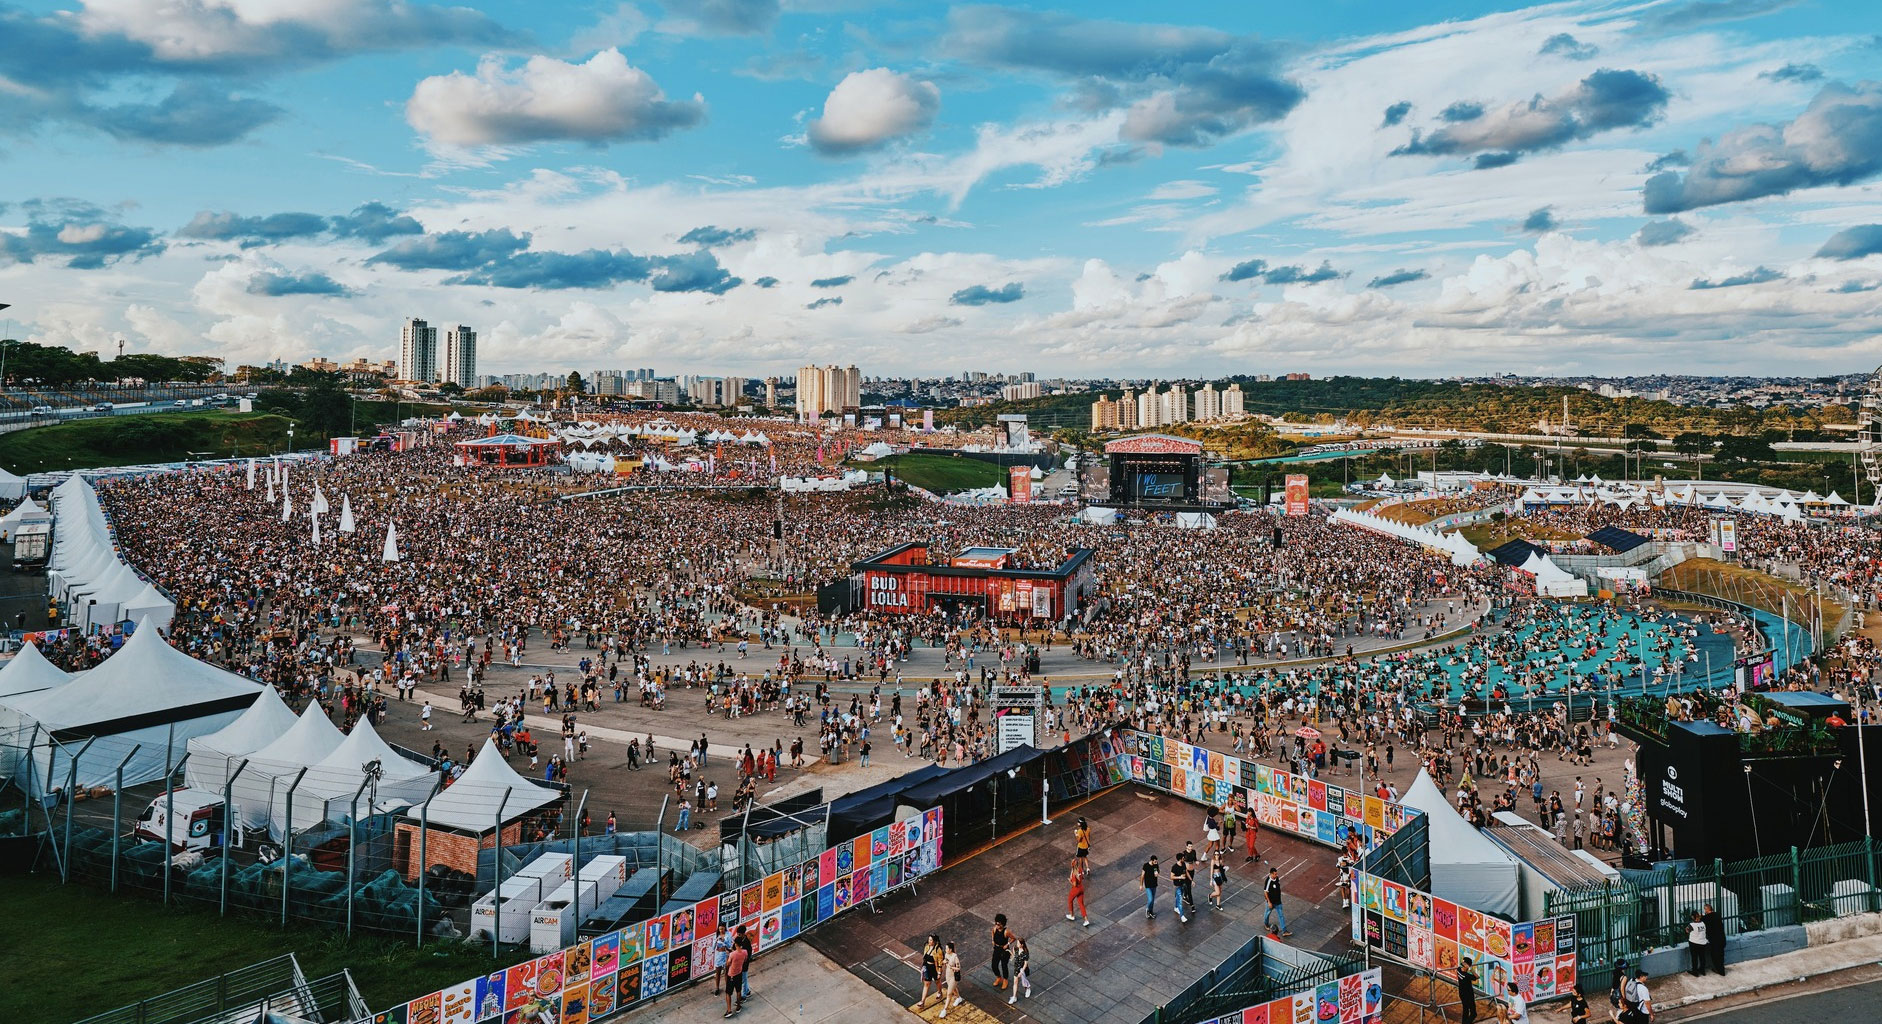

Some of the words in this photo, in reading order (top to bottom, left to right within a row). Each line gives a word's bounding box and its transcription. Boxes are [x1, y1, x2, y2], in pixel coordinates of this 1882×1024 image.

[1144, 482, 1182, 496] FEET
[1662, 779, 1683, 796] MULTI
[1662, 786, 1684, 804] SHOW
[1660, 798, 1688, 819] globoplay
[533, 917, 558, 925] AIRCAM
